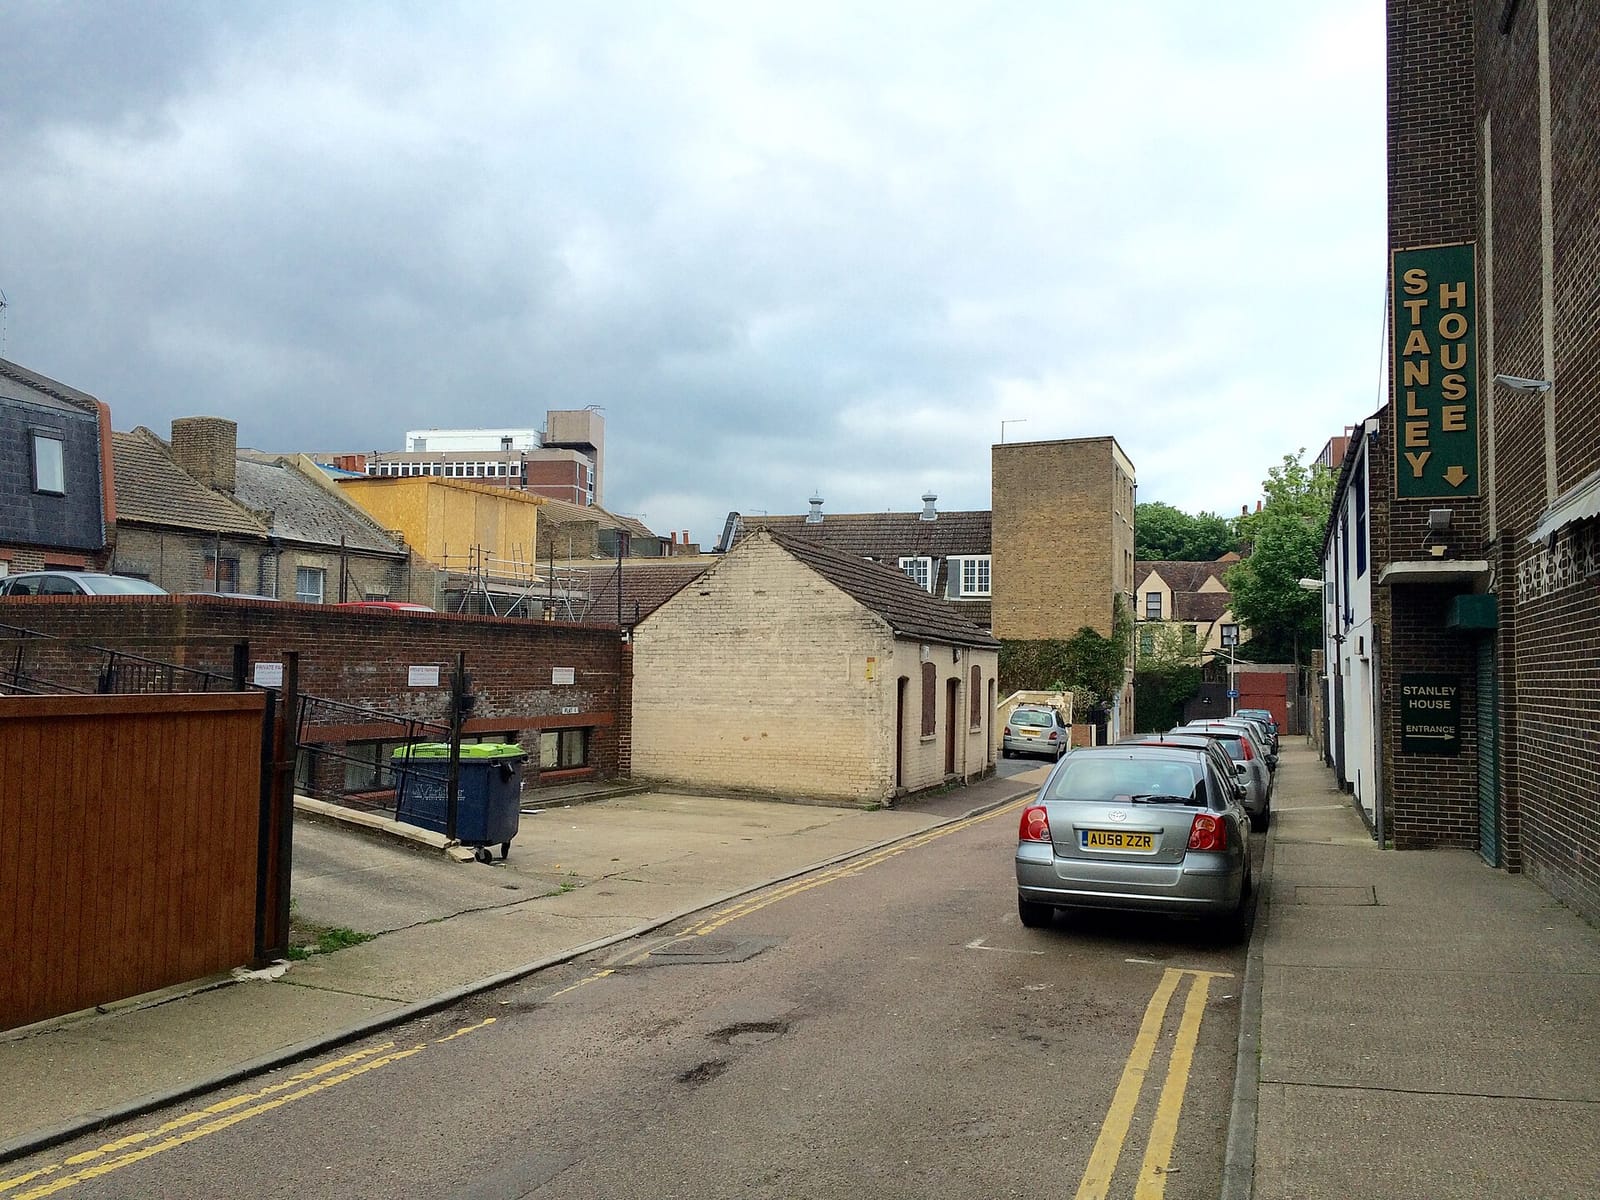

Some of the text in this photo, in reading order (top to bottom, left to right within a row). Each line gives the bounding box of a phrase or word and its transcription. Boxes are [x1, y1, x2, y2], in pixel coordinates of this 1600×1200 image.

[1438, 281, 1468, 432] HOUSE
[1402, 268, 1432, 478] STANLEY
[1403, 686, 1456, 696] STANLEY
[1409, 699, 1451, 709] HOUSE
[1406, 725, 1456, 734] ENTRANCE
[1090, 833, 1152, 848] AU58 ZZR
